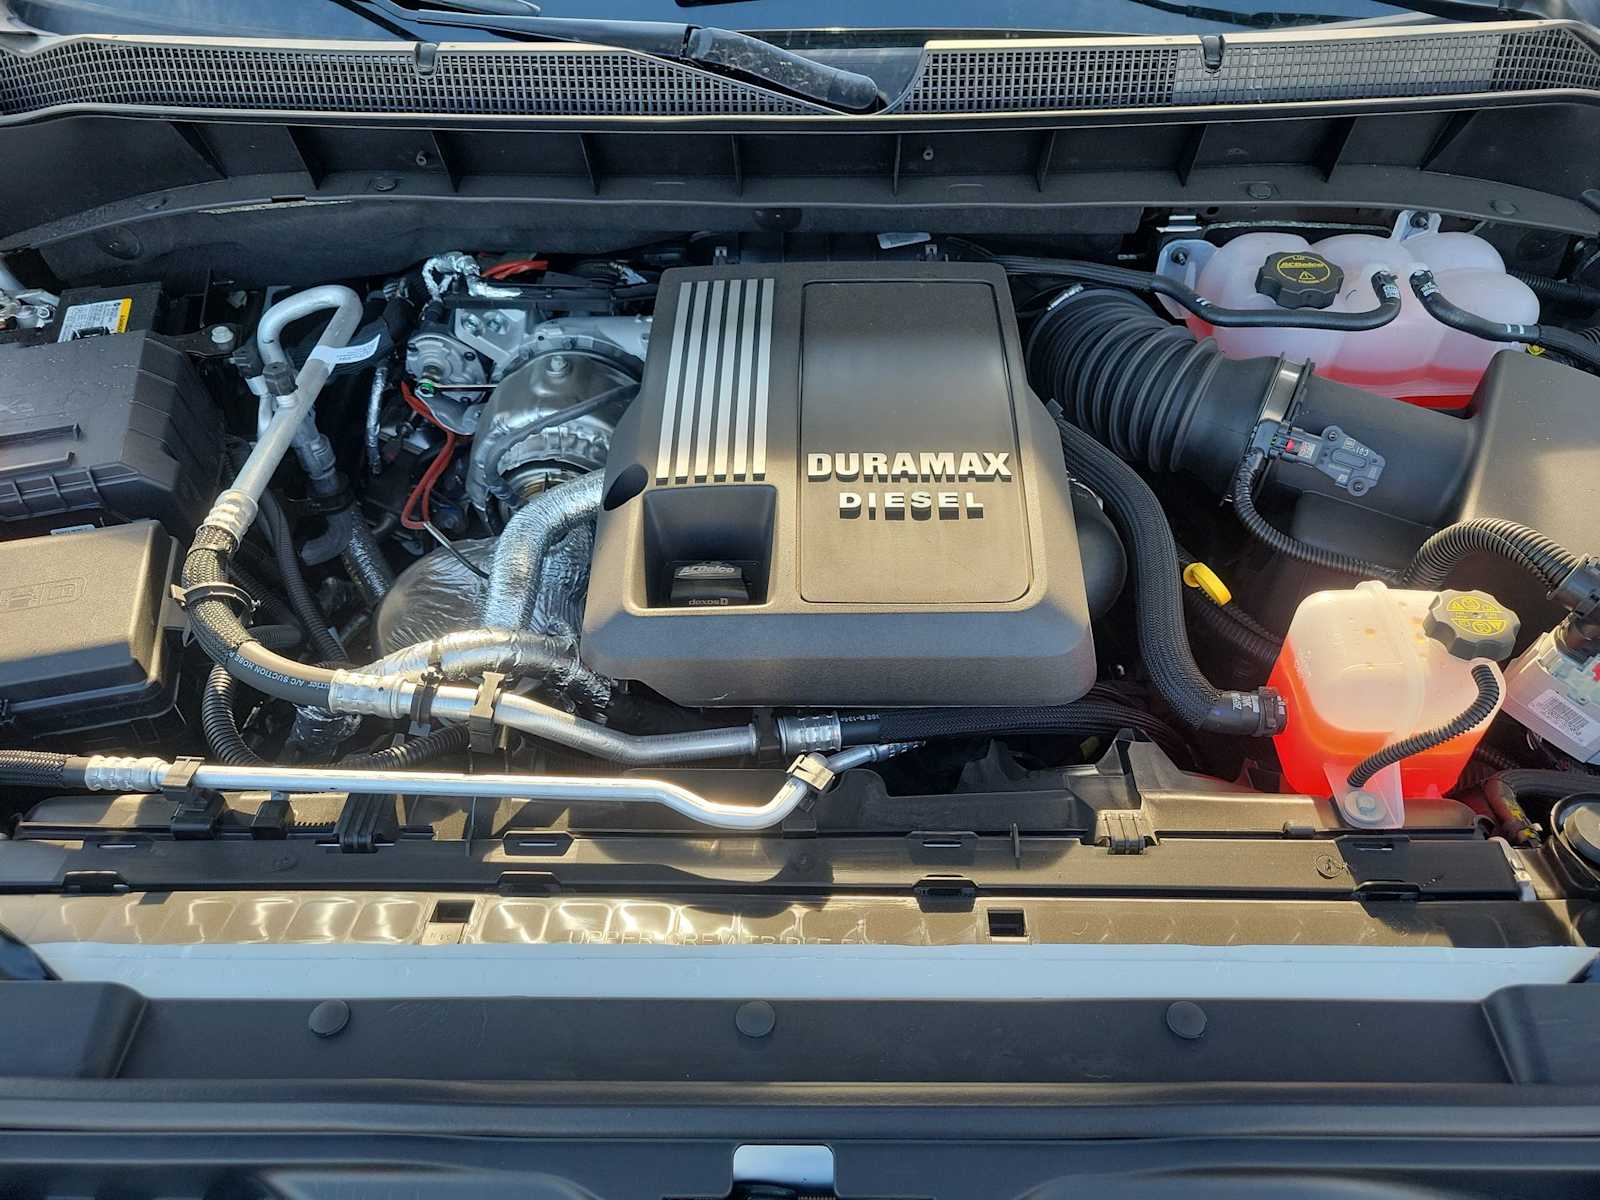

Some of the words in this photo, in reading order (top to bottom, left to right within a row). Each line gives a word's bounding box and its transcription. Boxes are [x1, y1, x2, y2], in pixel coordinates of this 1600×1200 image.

[807, 452, 1012, 482] DURAMAX
[839, 491, 984, 520] DIESEL
[234, 654, 254, 670] HOSE
[254, 667, 289, 683] SUCTION
